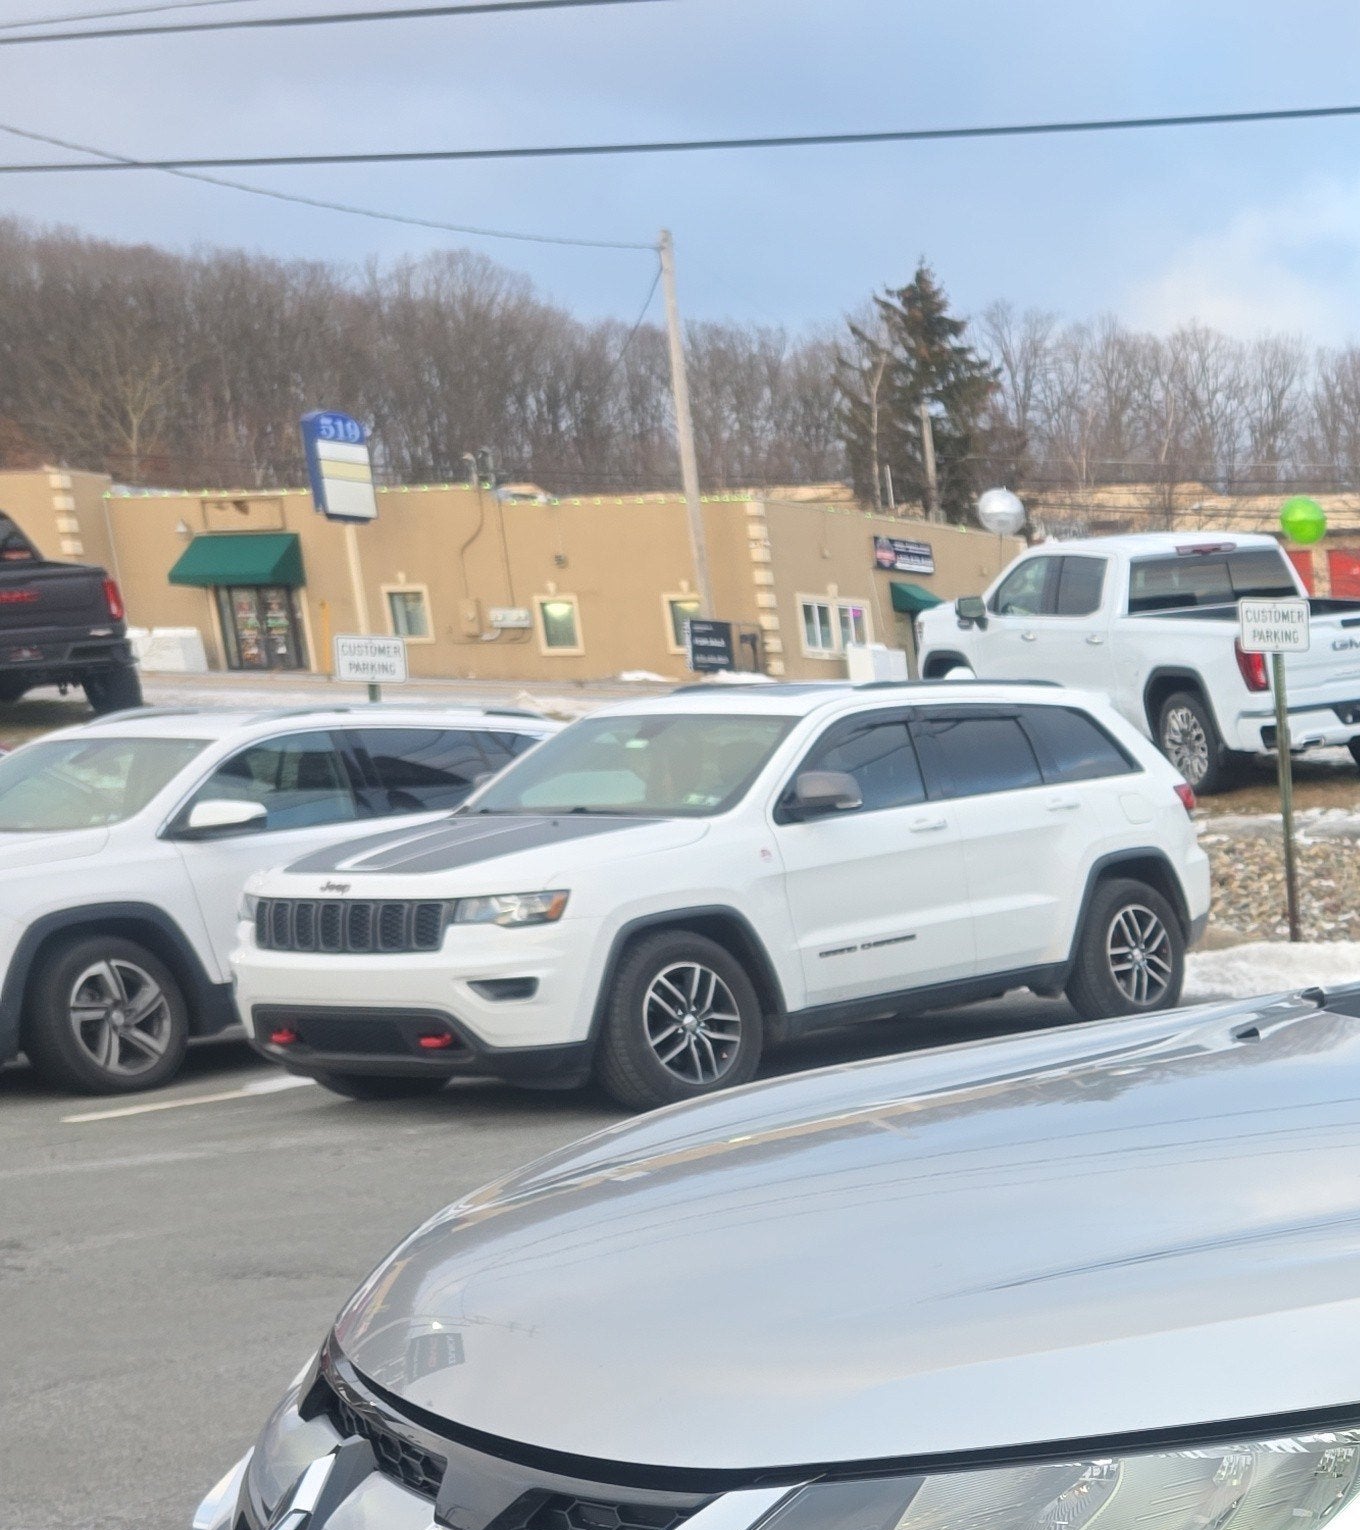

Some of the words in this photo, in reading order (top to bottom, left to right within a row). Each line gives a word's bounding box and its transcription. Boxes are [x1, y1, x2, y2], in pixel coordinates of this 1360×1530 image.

[319, 417, 361, 443] 519
[1245, 608, 1305, 624] CUSTOMER
[1252, 628, 1299, 644] PARKING
[341, 643, 402, 658] CUSTOMER
[348, 662, 396, 676] PARKING
[319, 880, 352, 896] Jeep
